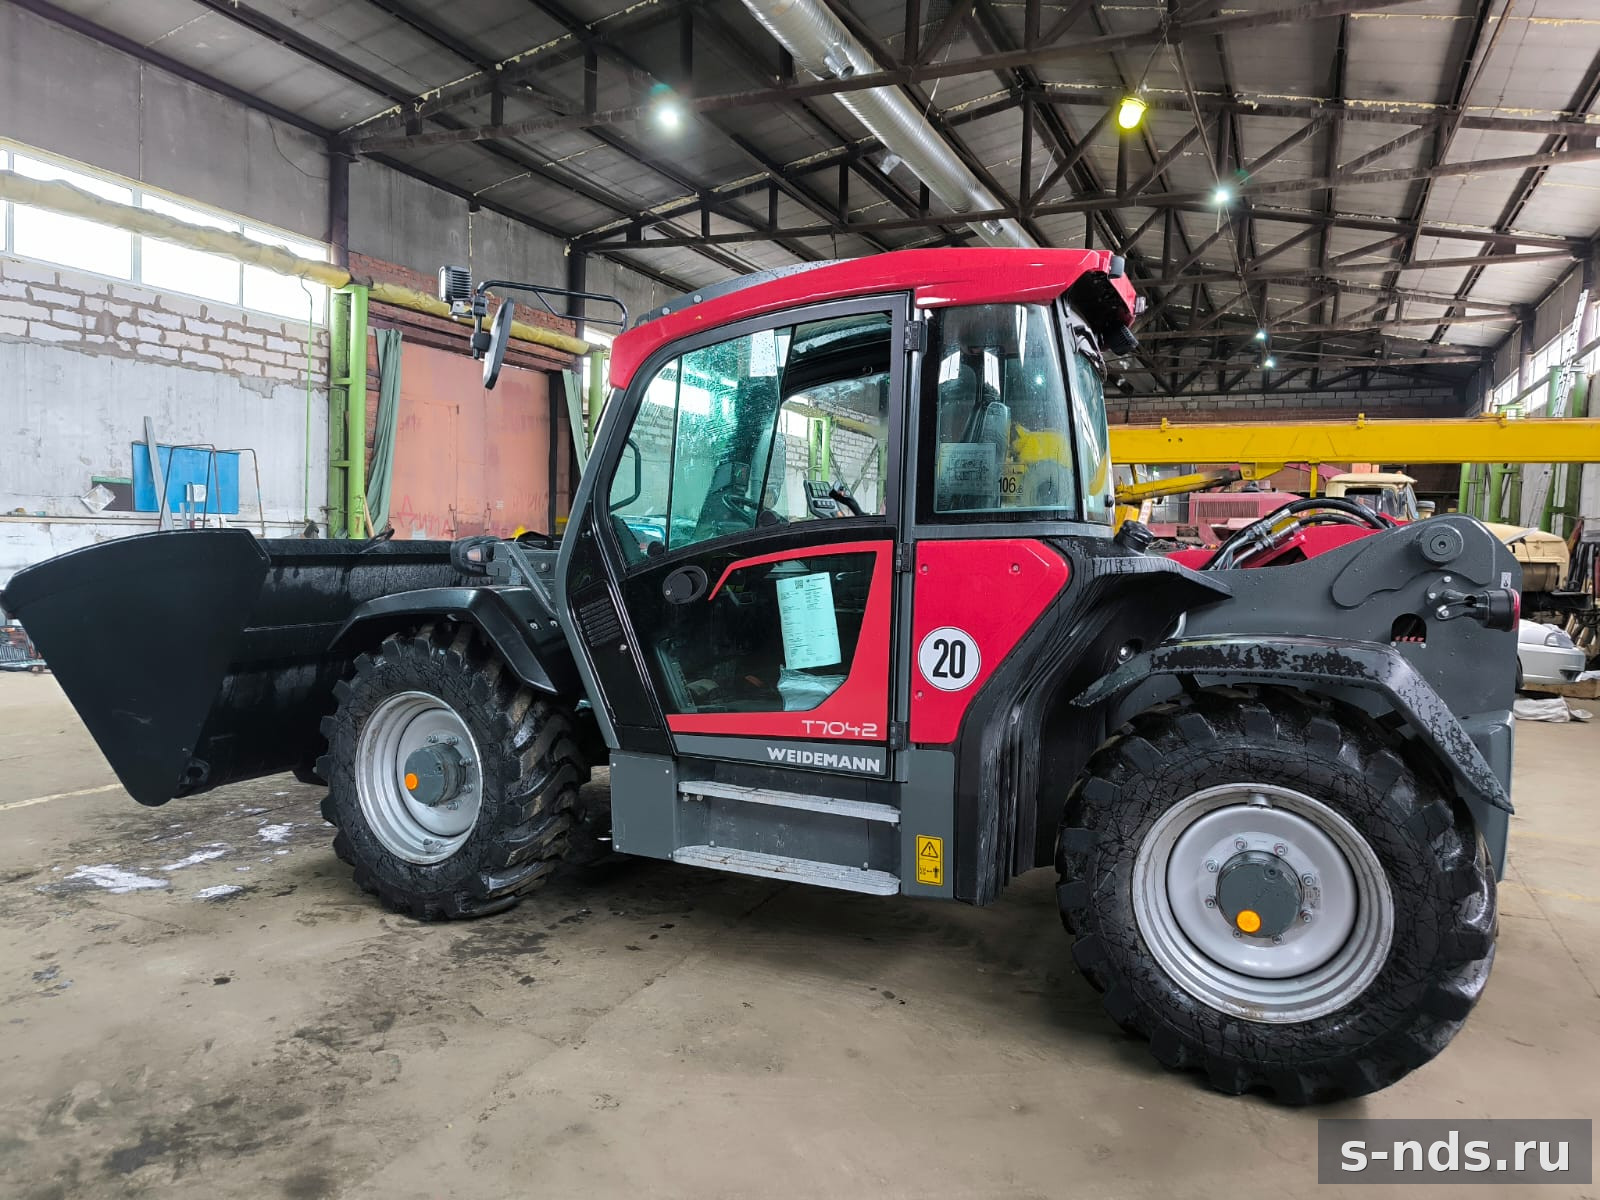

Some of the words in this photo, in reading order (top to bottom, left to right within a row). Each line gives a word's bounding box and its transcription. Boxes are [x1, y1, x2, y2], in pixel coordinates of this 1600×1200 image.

[998, 477, 1016, 494] 106
[932, 638, 966, 679] 20
[802, 720, 877, 737] T7042
[766, 746, 880, 773] WEIDEMANN
